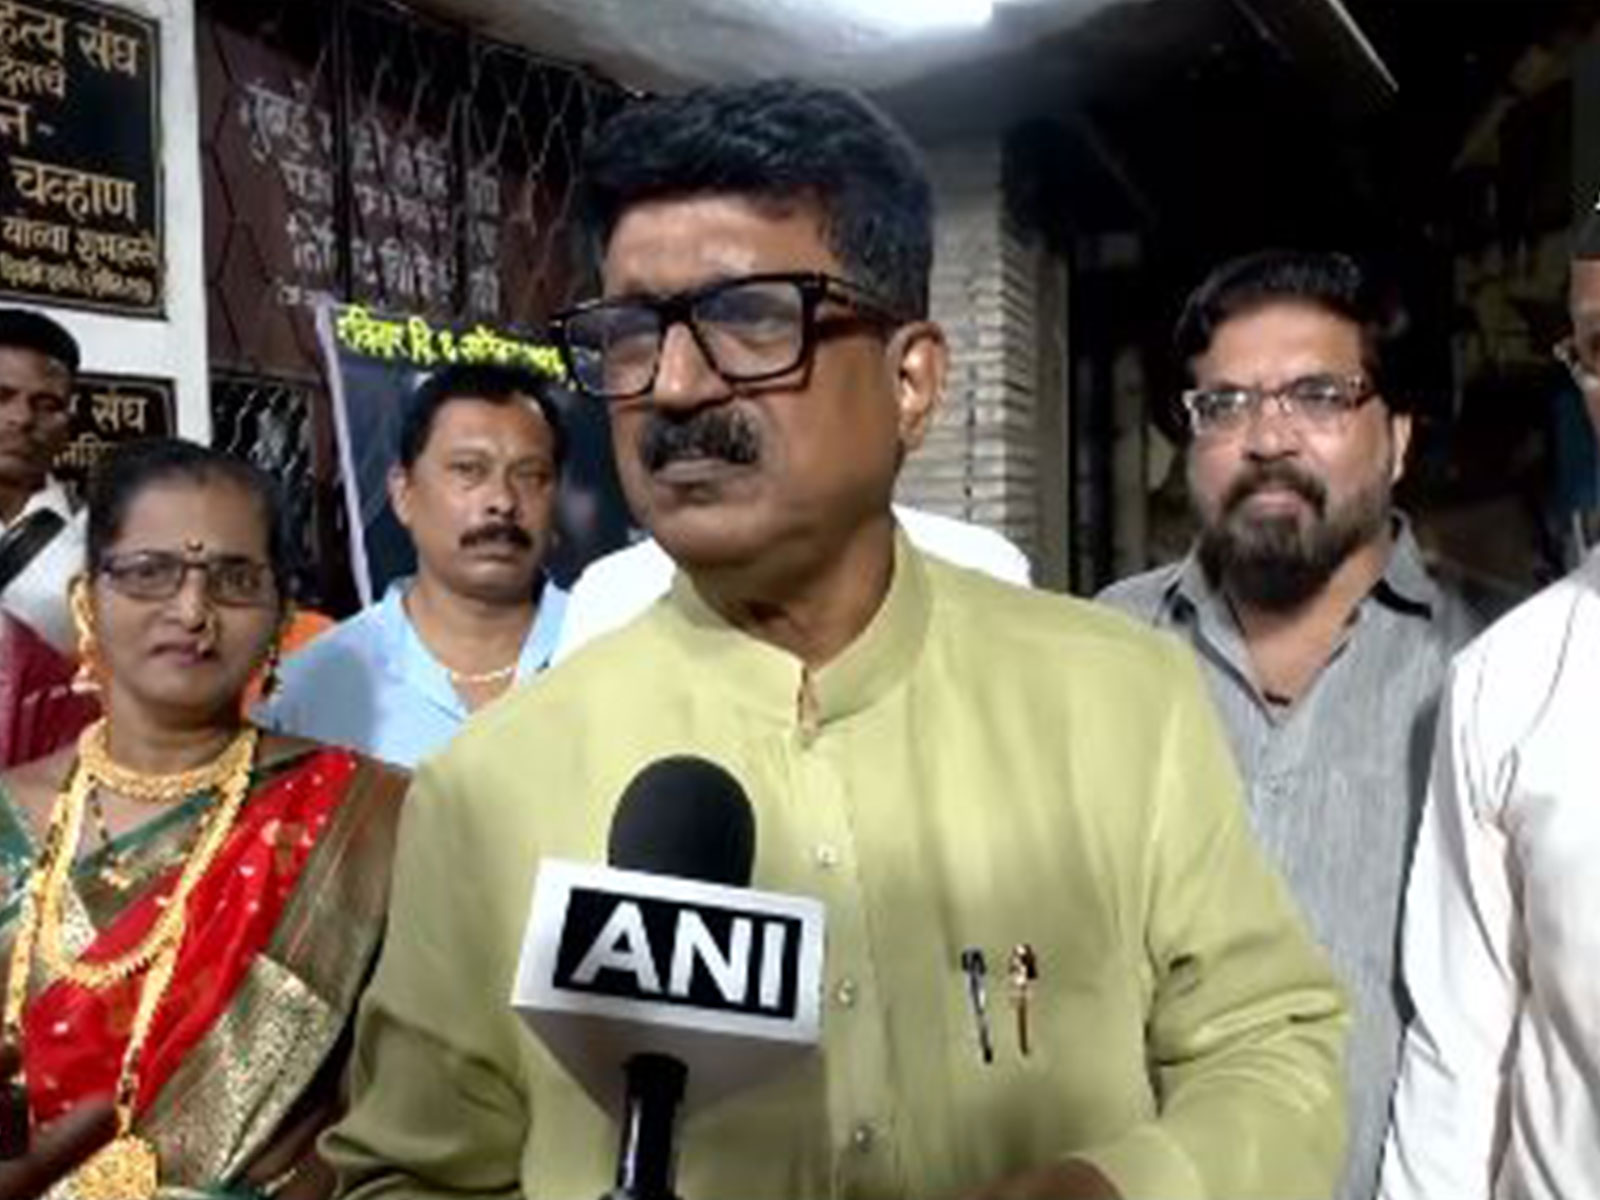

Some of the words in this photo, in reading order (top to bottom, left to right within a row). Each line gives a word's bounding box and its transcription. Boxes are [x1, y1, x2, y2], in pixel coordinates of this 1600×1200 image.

[78, 20, 138, 77] संघ
[10, 156, 136, 223] चव्हाण
[569, 899, 787, 1010] ANI
